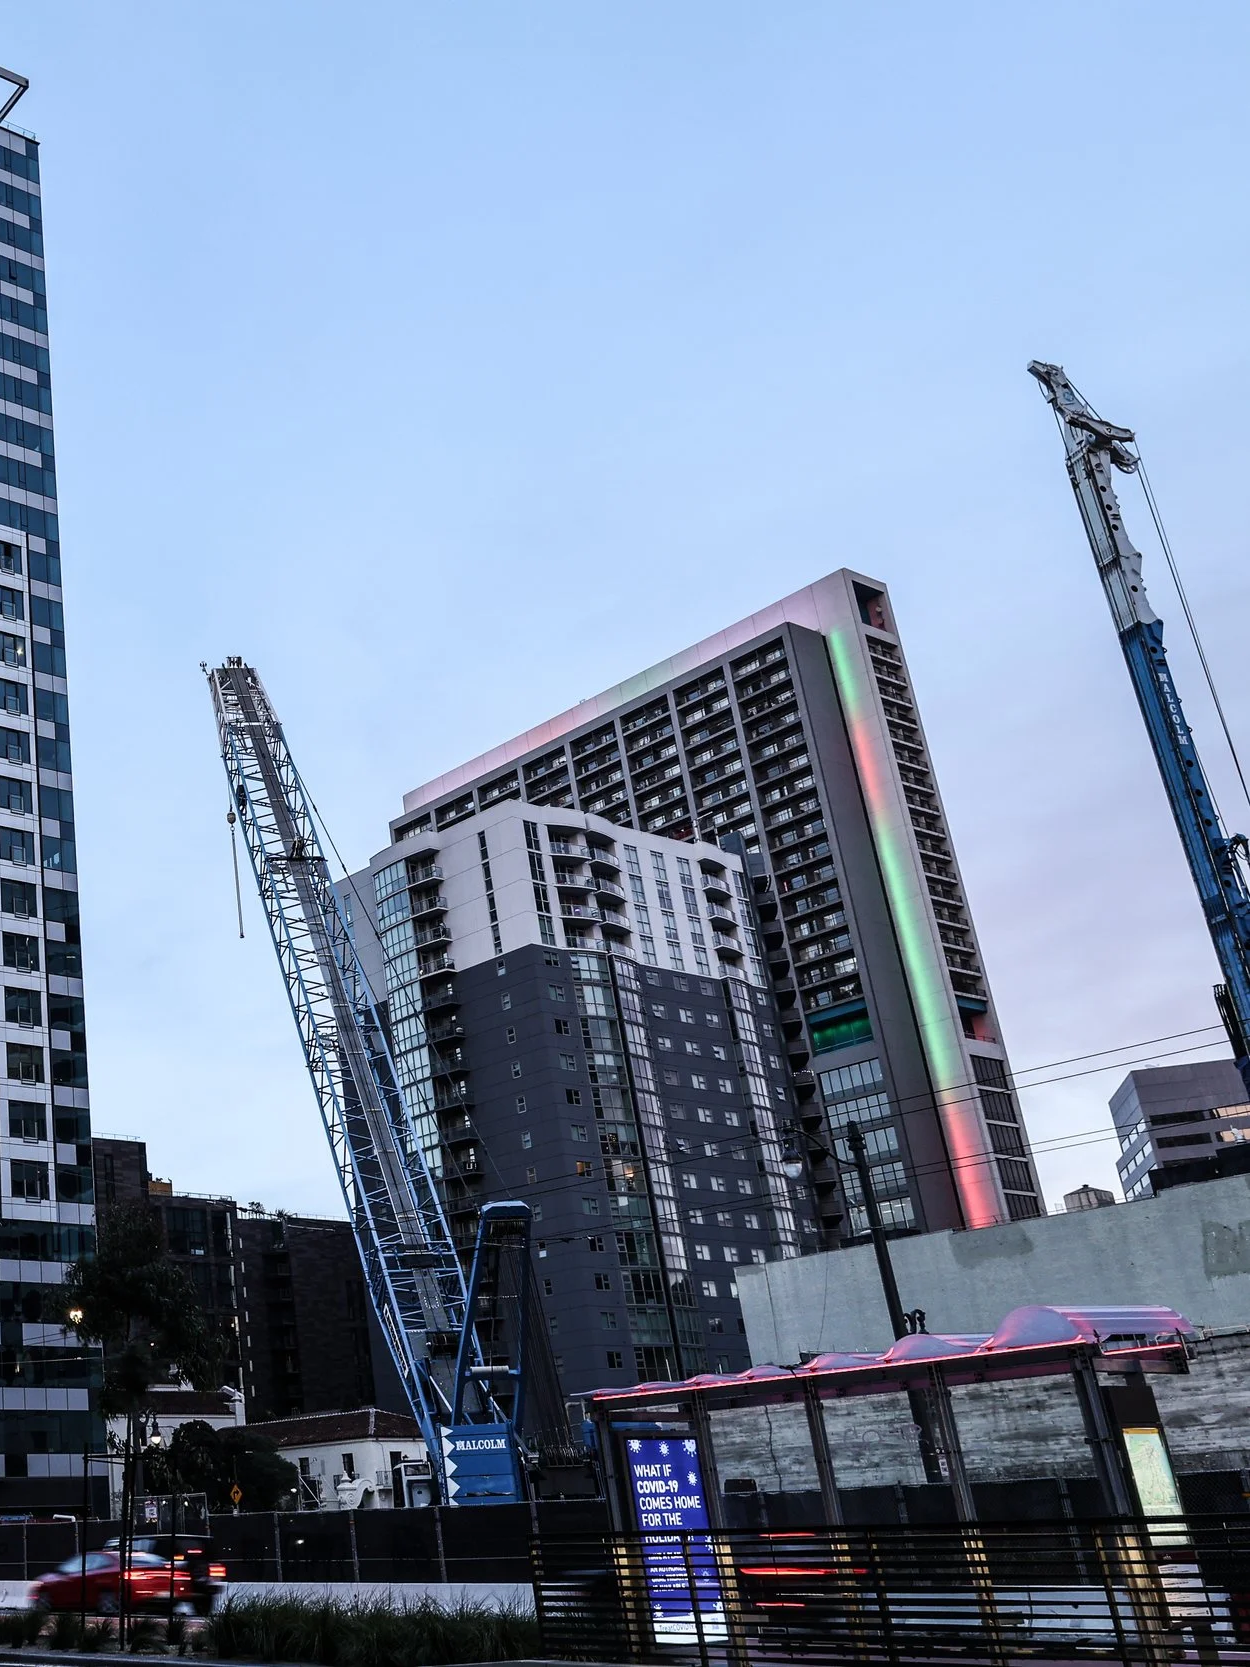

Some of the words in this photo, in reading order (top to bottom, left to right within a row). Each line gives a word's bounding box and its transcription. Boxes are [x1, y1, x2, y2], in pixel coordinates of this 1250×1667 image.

[1158, 673, 1188, 745] MALCOLM
[456, 1438, 507, 1451] MALCOLM
[634, 1464, 661, 1477] WHAT
[662, 1463, 672, 1477] IF
[636, 1479, 679, 1493] COVID-19
[639, 1496, 673, 1510] COMES
[673, 1495, 702, 1509] HOME
[641, 1513, 662, 1527] FOR
[662, 1512, 683, 1526] THE
